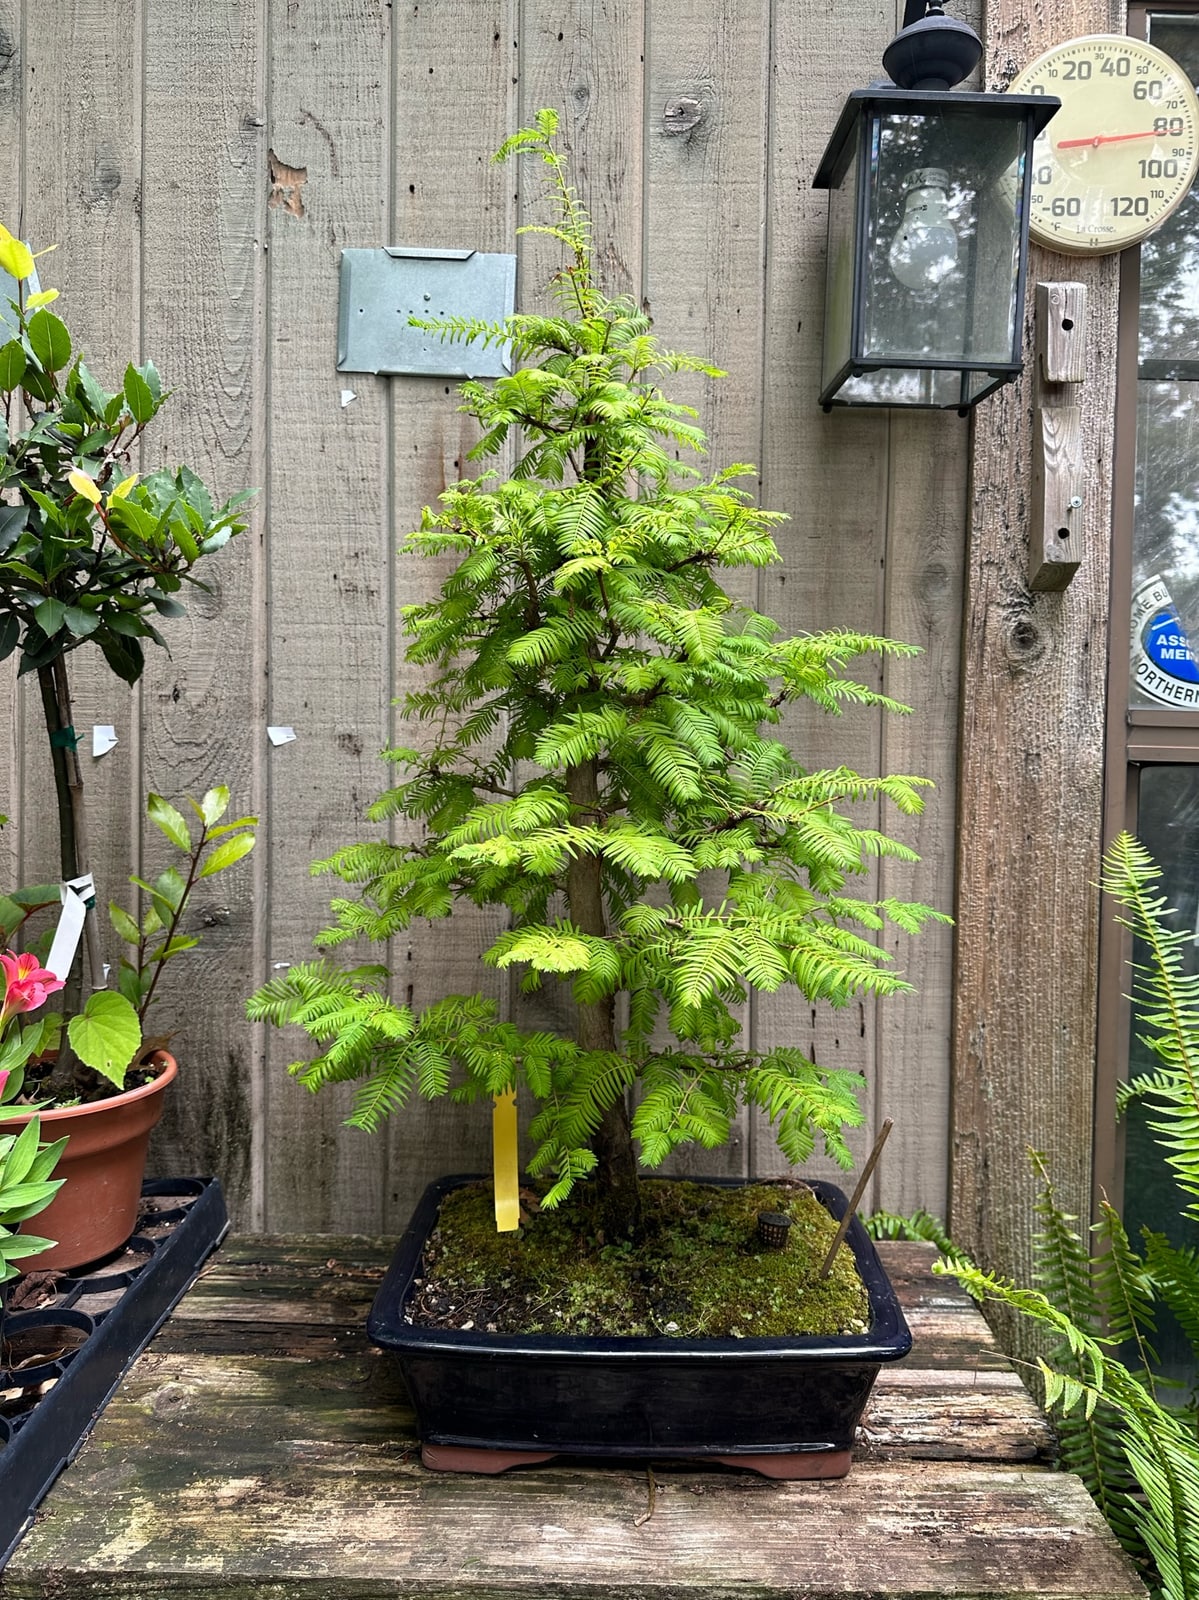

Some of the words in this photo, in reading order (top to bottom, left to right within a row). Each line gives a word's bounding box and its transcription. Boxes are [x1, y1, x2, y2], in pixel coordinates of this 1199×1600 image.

[1049, 69, 1058, 78] 10
[1062, 61, 1092, 80] 20
[1100, 57, 1131, 77] 40
[1136, 66, 1149, 75] 50
[1133, 81, 1163, 100] 60
[1166, 101, 1178, 109] 70
[1154, 117, 1184, 137] 80
[1172, 148, 1185, 157] 90
[1138, 159, 1178, 178] 100
[1150, 190, 1165, 199] 110
[1042, 197, 1081, 217] -60
[1110, 197, 1149, 217] 120
[1130, 653, 1199, 703] NORTHER
